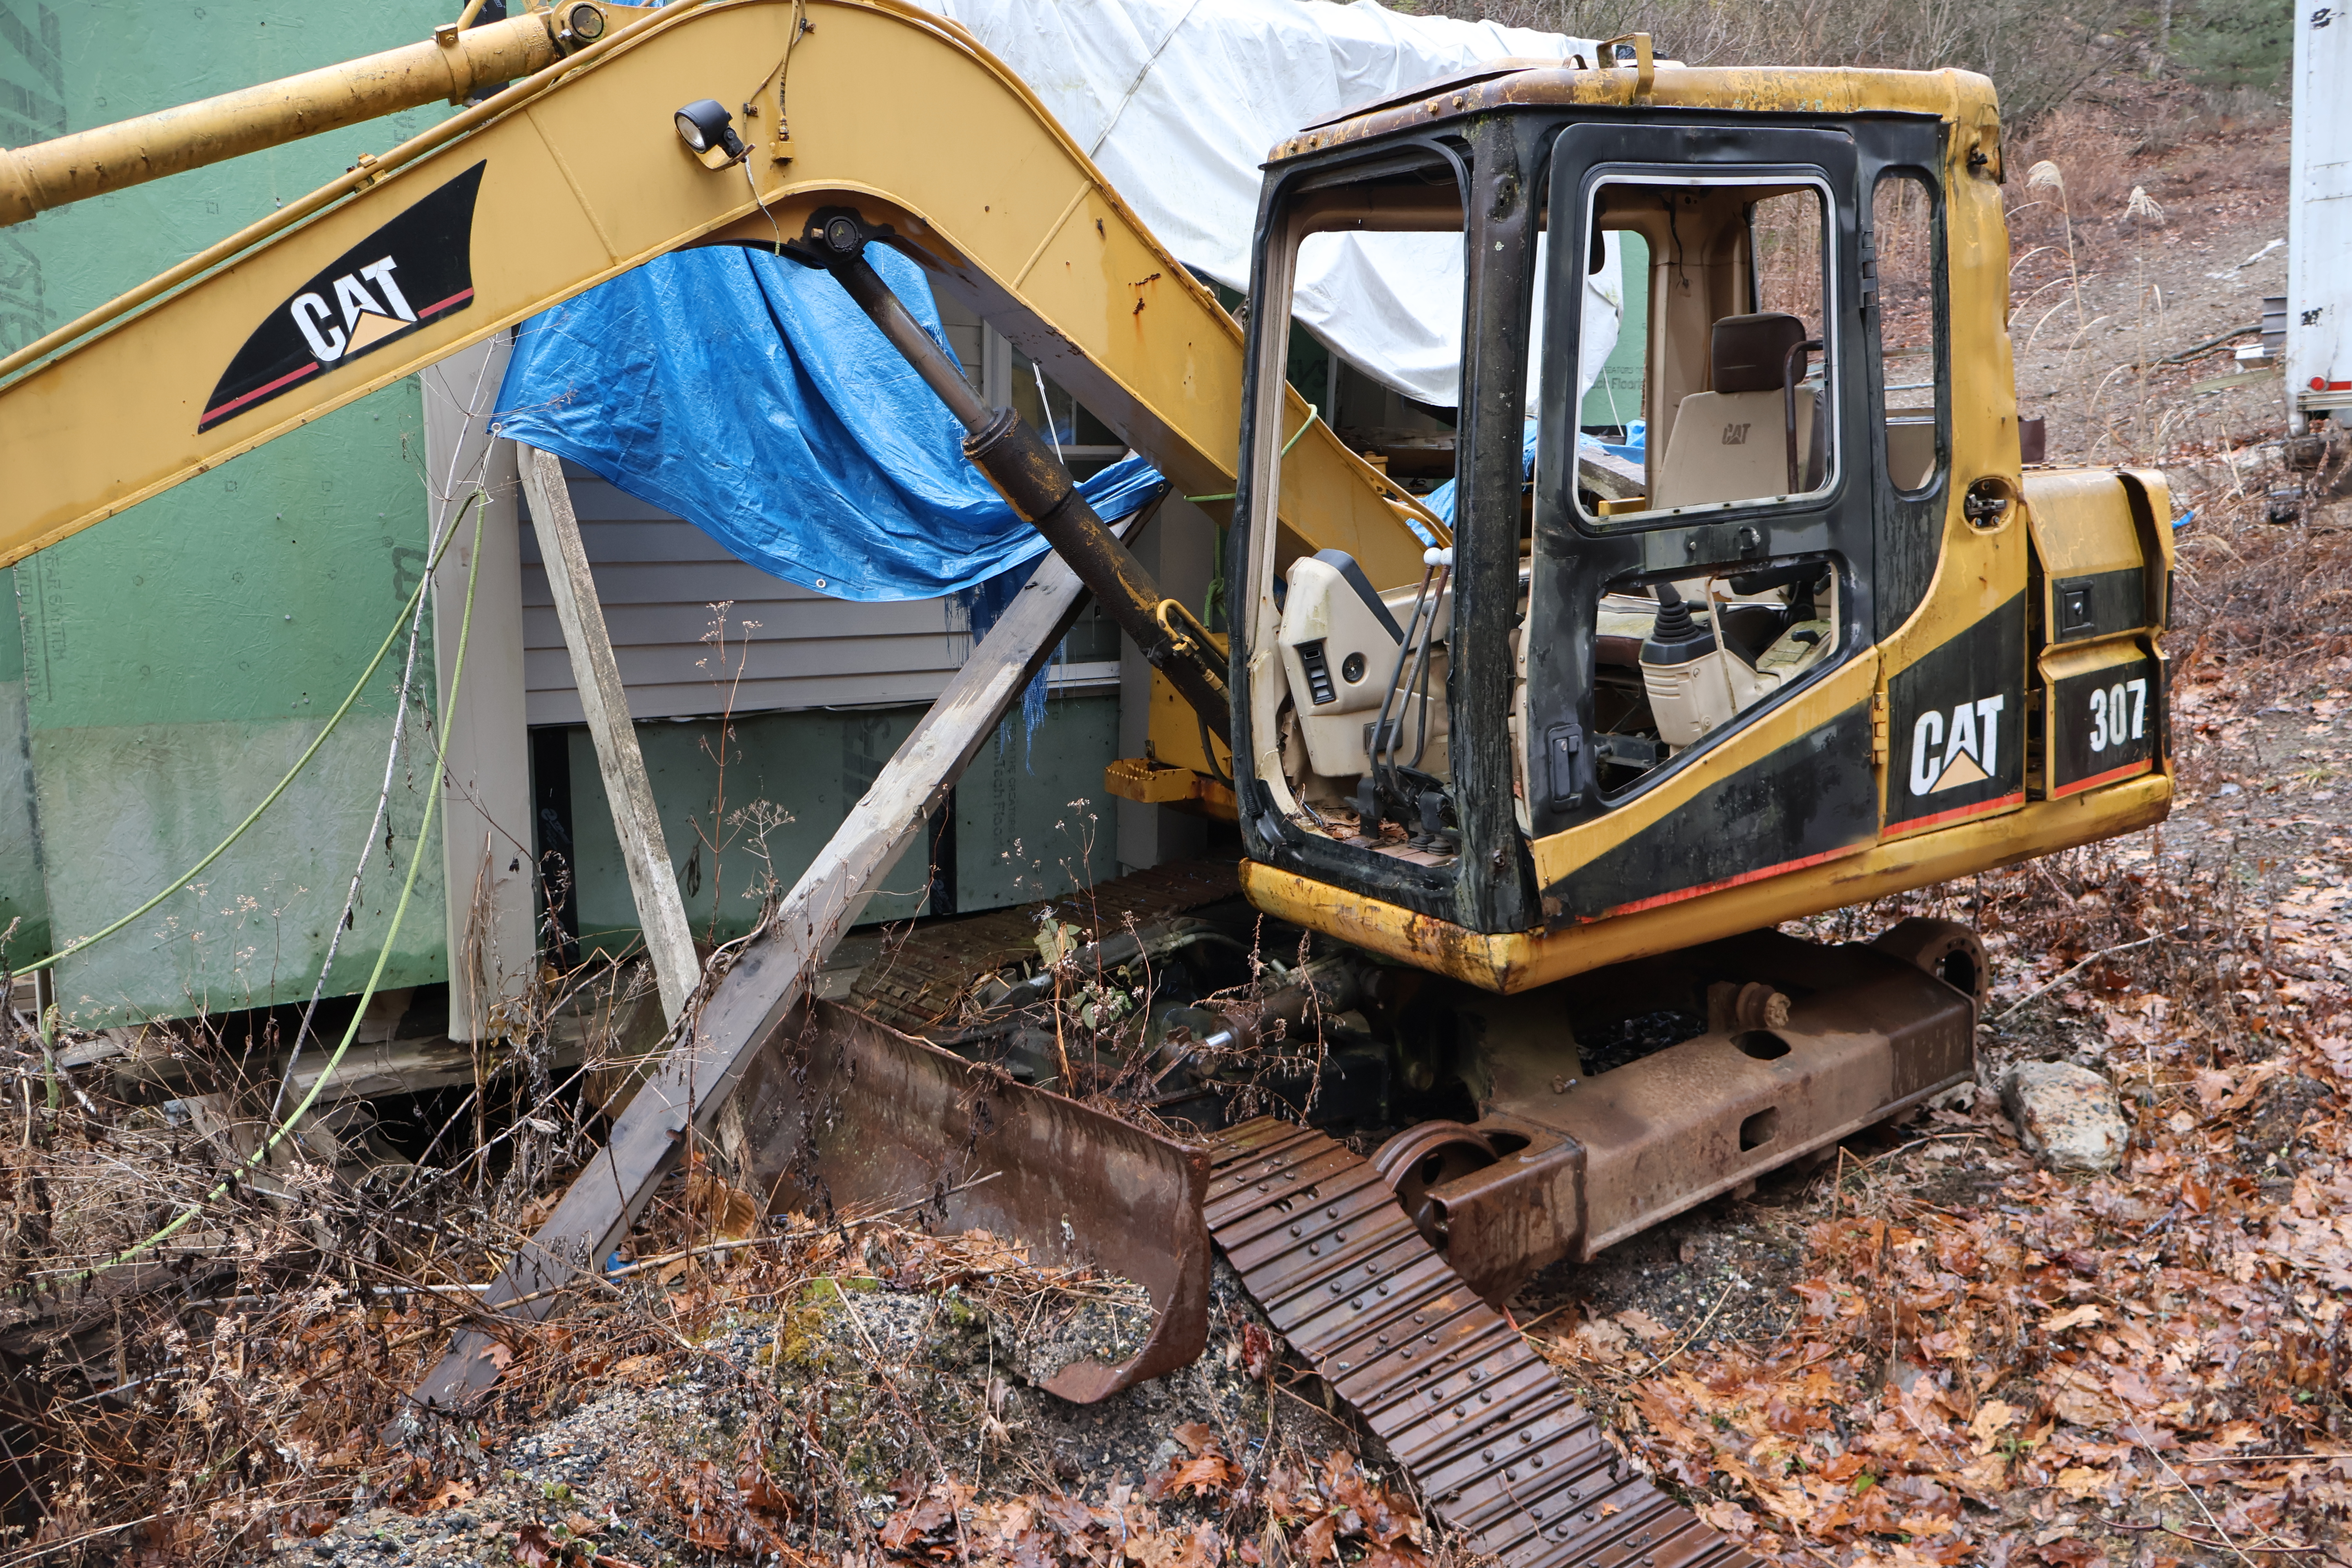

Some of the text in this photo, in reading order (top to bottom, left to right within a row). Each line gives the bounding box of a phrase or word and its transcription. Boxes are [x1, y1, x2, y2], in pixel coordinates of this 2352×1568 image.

[291, 255, 417, 361] CAT
[1722, 423, 1751, 445] CAT
[1909, 694, 2004, 796] CAT
[2090, 678, 2146, 752] 307
